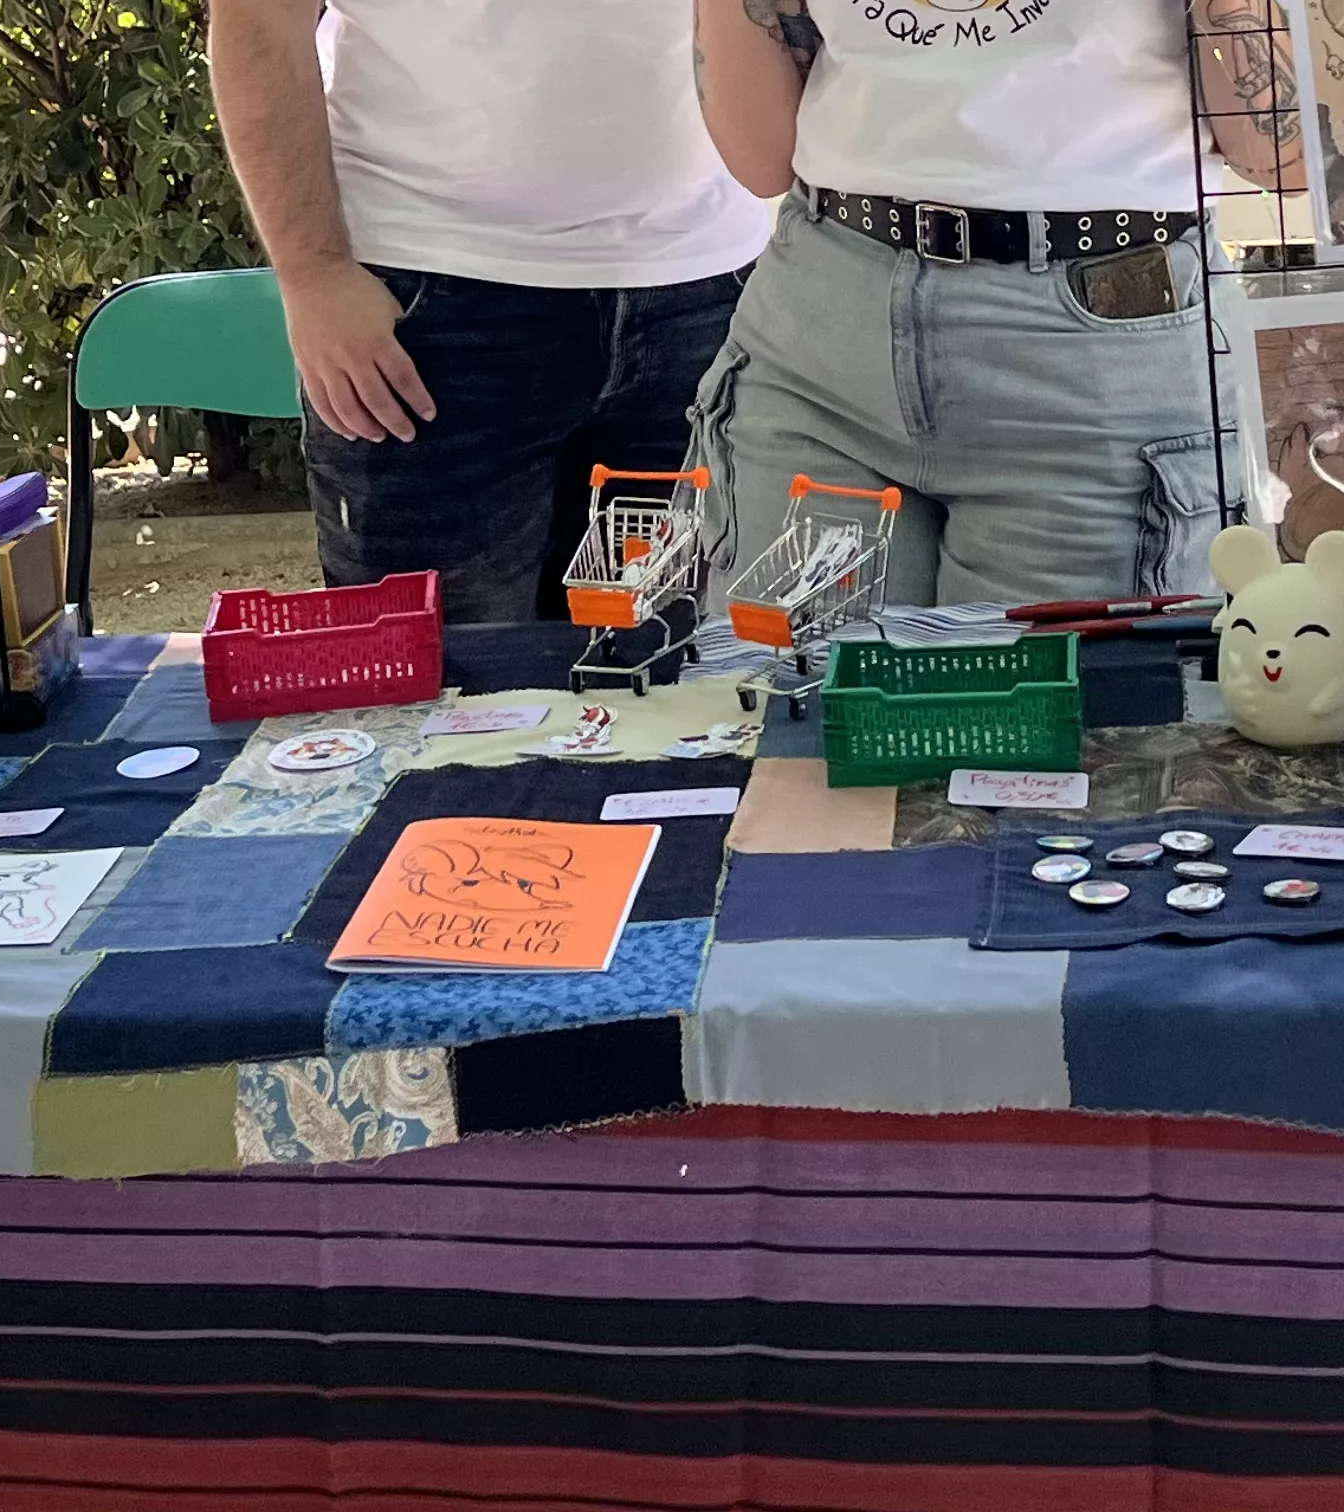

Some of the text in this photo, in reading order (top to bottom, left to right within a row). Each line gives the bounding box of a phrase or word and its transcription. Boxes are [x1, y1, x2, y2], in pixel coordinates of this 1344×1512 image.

[885, 9, 945, 46] Qué
[953, 17, 997, 47] Me
[380, 910, 578, 936] NADIE ME
[367, 928, 561, 954] ESCUCHA
